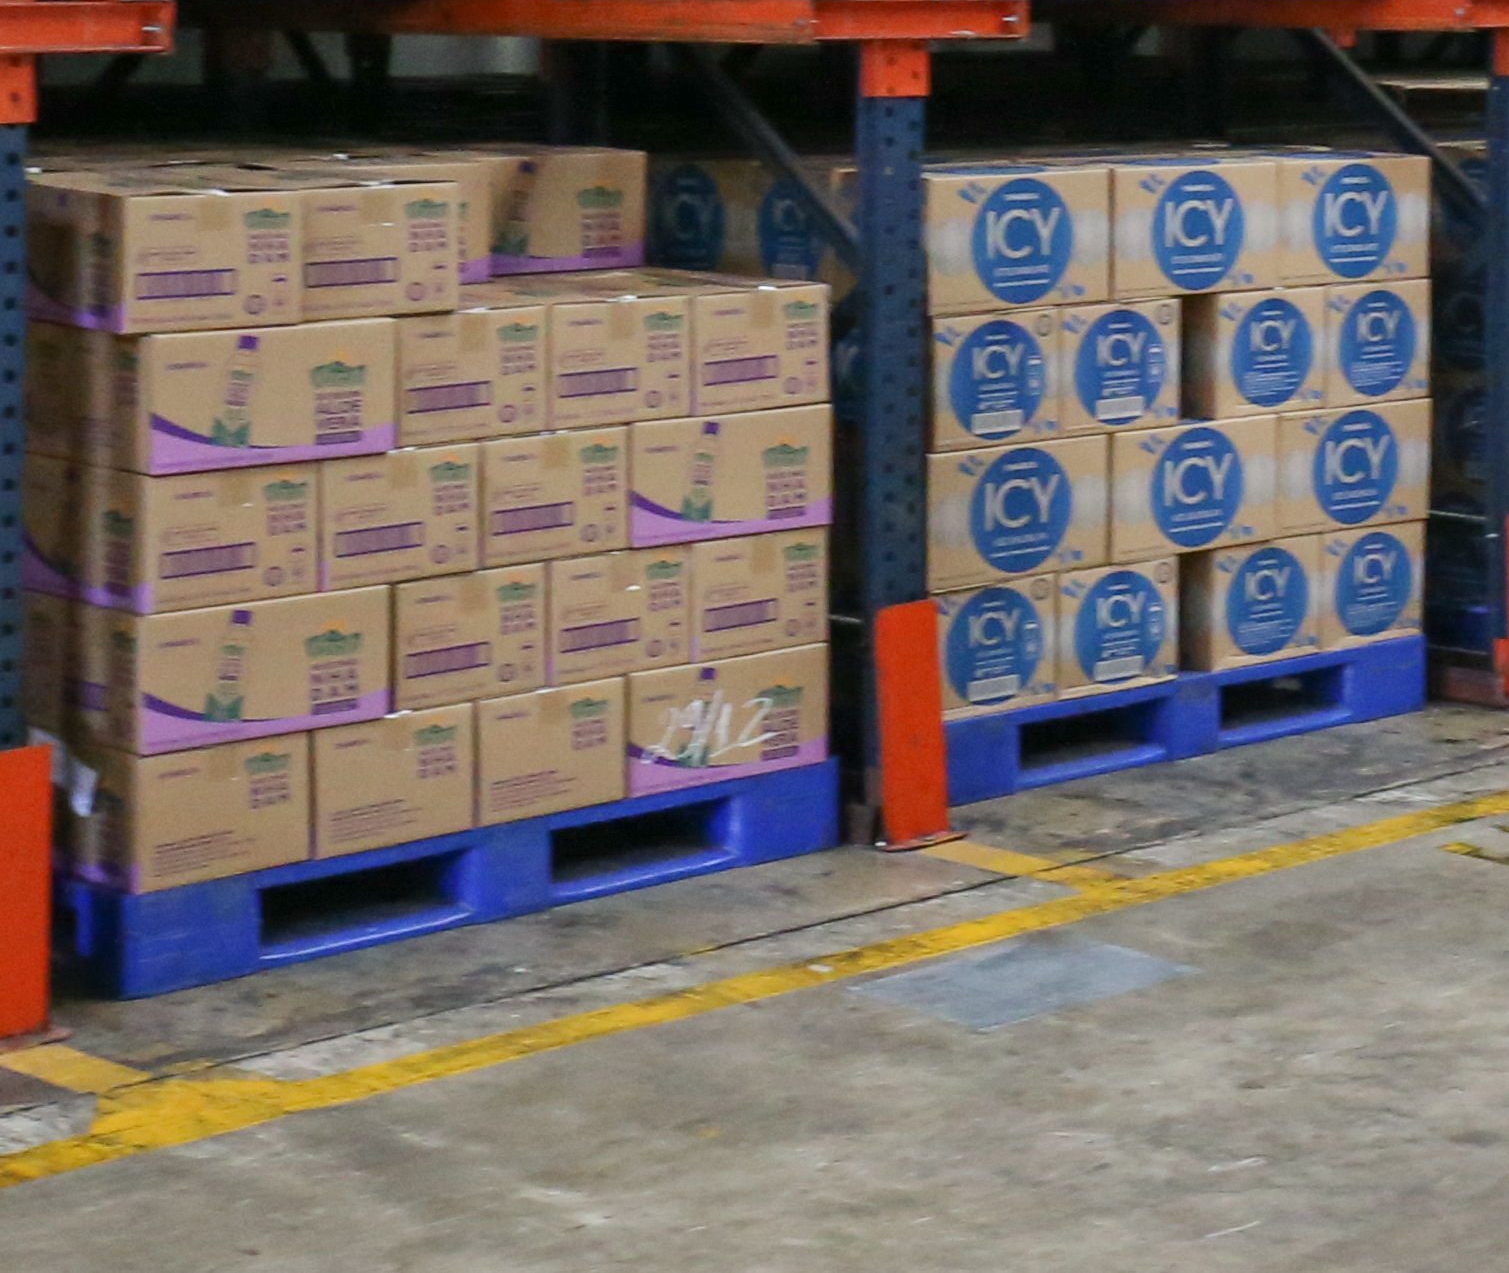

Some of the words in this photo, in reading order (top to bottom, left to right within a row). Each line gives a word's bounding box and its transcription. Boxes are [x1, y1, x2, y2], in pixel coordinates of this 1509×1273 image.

[1165, 197, 1234, 247] ICY
[1323, 190, 1389, 237] ICY
[987, 208, 1061, 259] ICY
[1249, 320, 1295, 352] ICY
[1356, 311, 1401, 342] ICY
[971, 345, 1023, 379] ICY
[1096, 333, 1144, 366] ICY
[1324, 434, 1392, 484] ICY
[1164, 454, 1234, 505] ICY
[985, 475, 1058, 530] ICY
[1245, 568, 1289, 601] ICY
[1354, 554, 1396, 584] ICY
[968, 610, 1020, 646] ICY
[1096, 594, 1144, 628] ICY
